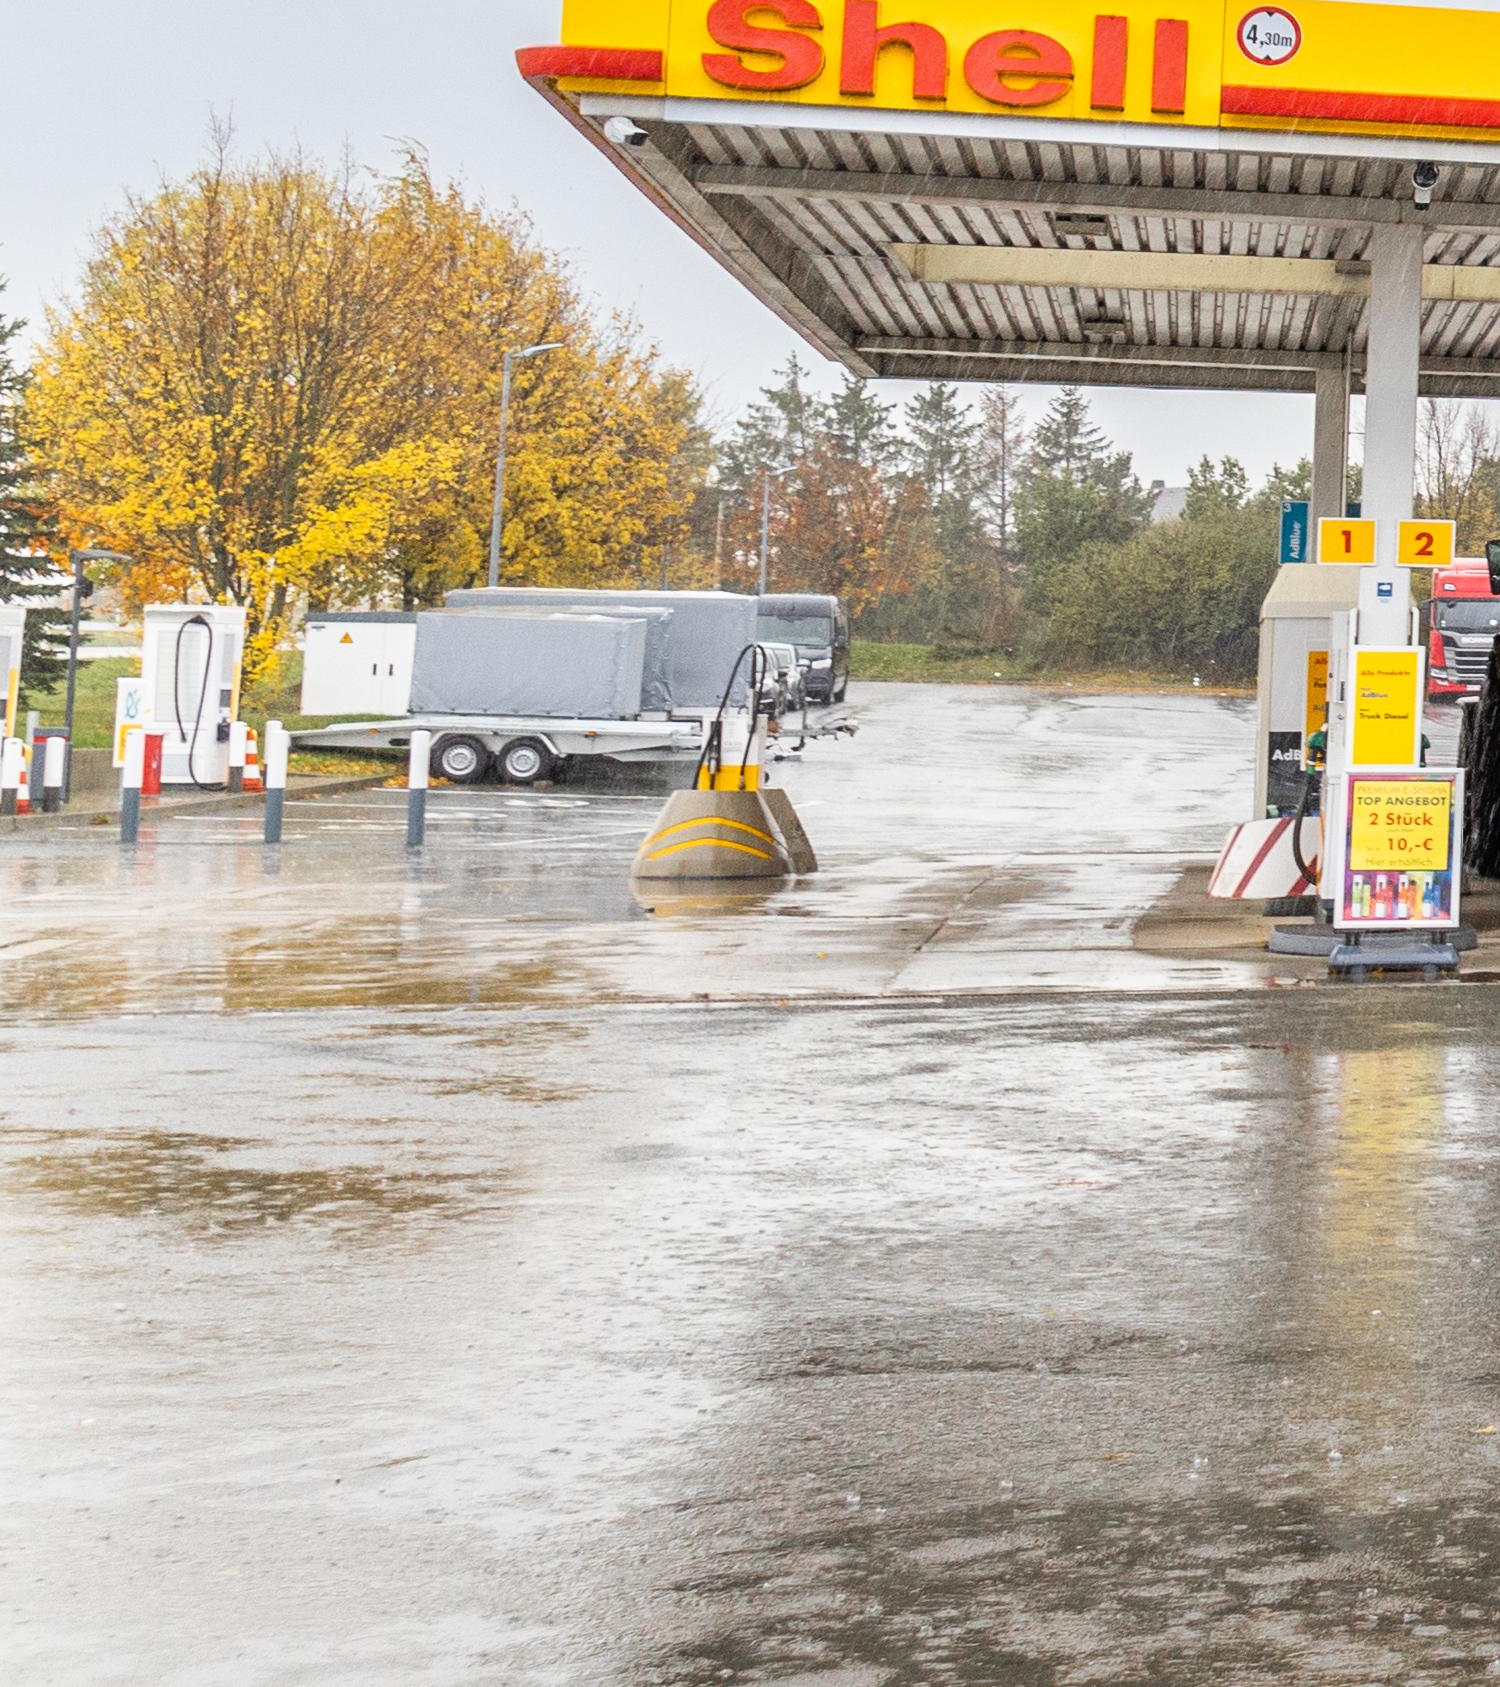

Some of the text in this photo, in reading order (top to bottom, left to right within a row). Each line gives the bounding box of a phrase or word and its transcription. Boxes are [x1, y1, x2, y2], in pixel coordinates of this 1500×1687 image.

[1246, 23, 1293, 48] 4,30m
[1341, 530, 1352, 553] 1
[1414, 532, 1434, 556] 2
[1357, 796, 1447, 806] TOP ANGEBOT
[1369, 812, 1434, 826] 2 Stück
[1387, 837, 1434, 853] 10,-€
